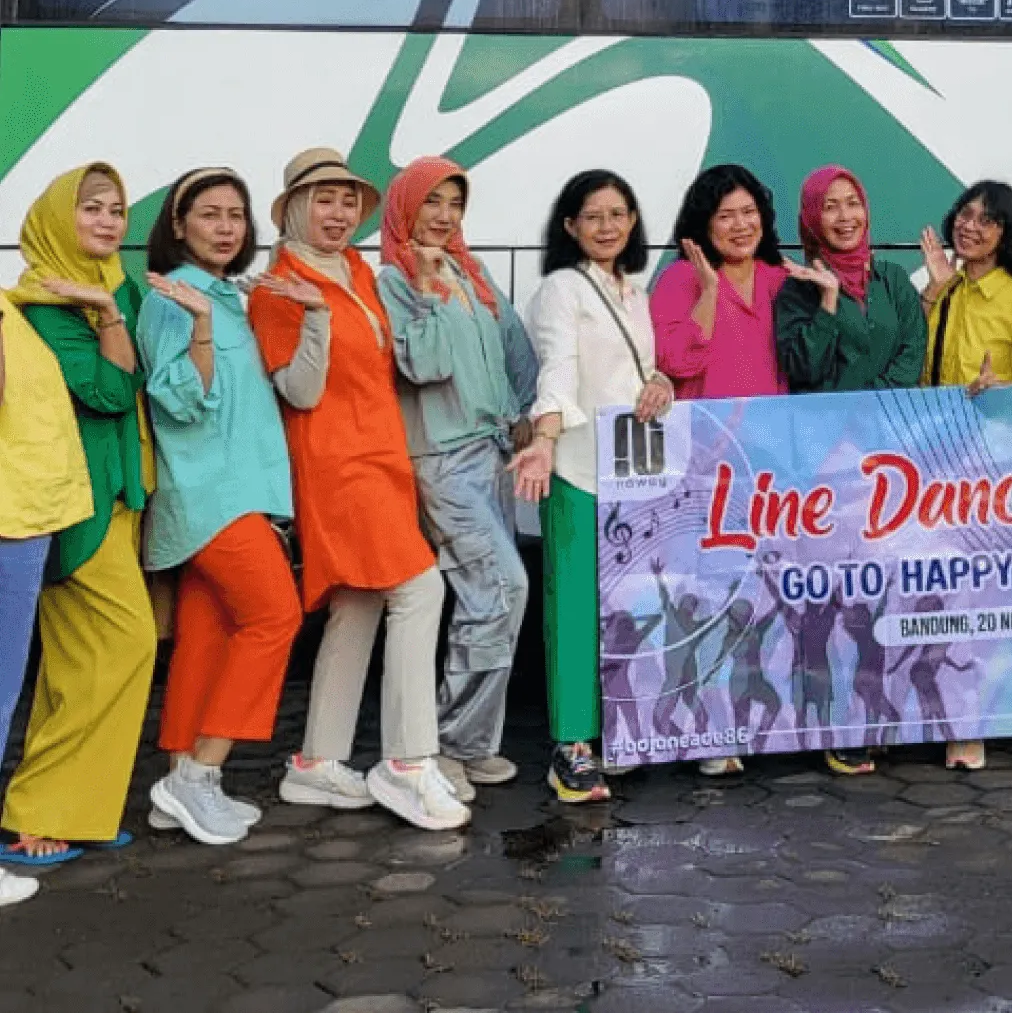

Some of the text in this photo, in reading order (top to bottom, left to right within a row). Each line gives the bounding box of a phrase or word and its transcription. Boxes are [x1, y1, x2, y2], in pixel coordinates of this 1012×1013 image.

[699, 462, 835, 551] Line
[782, 565, 829, 601] GO
[838, 562, 883, 597] TO
[901, 554, 1012, 593] HAPPY
[901, 615, 974, 638] BANDUNG,
[977, 613, 998, 633] 20
